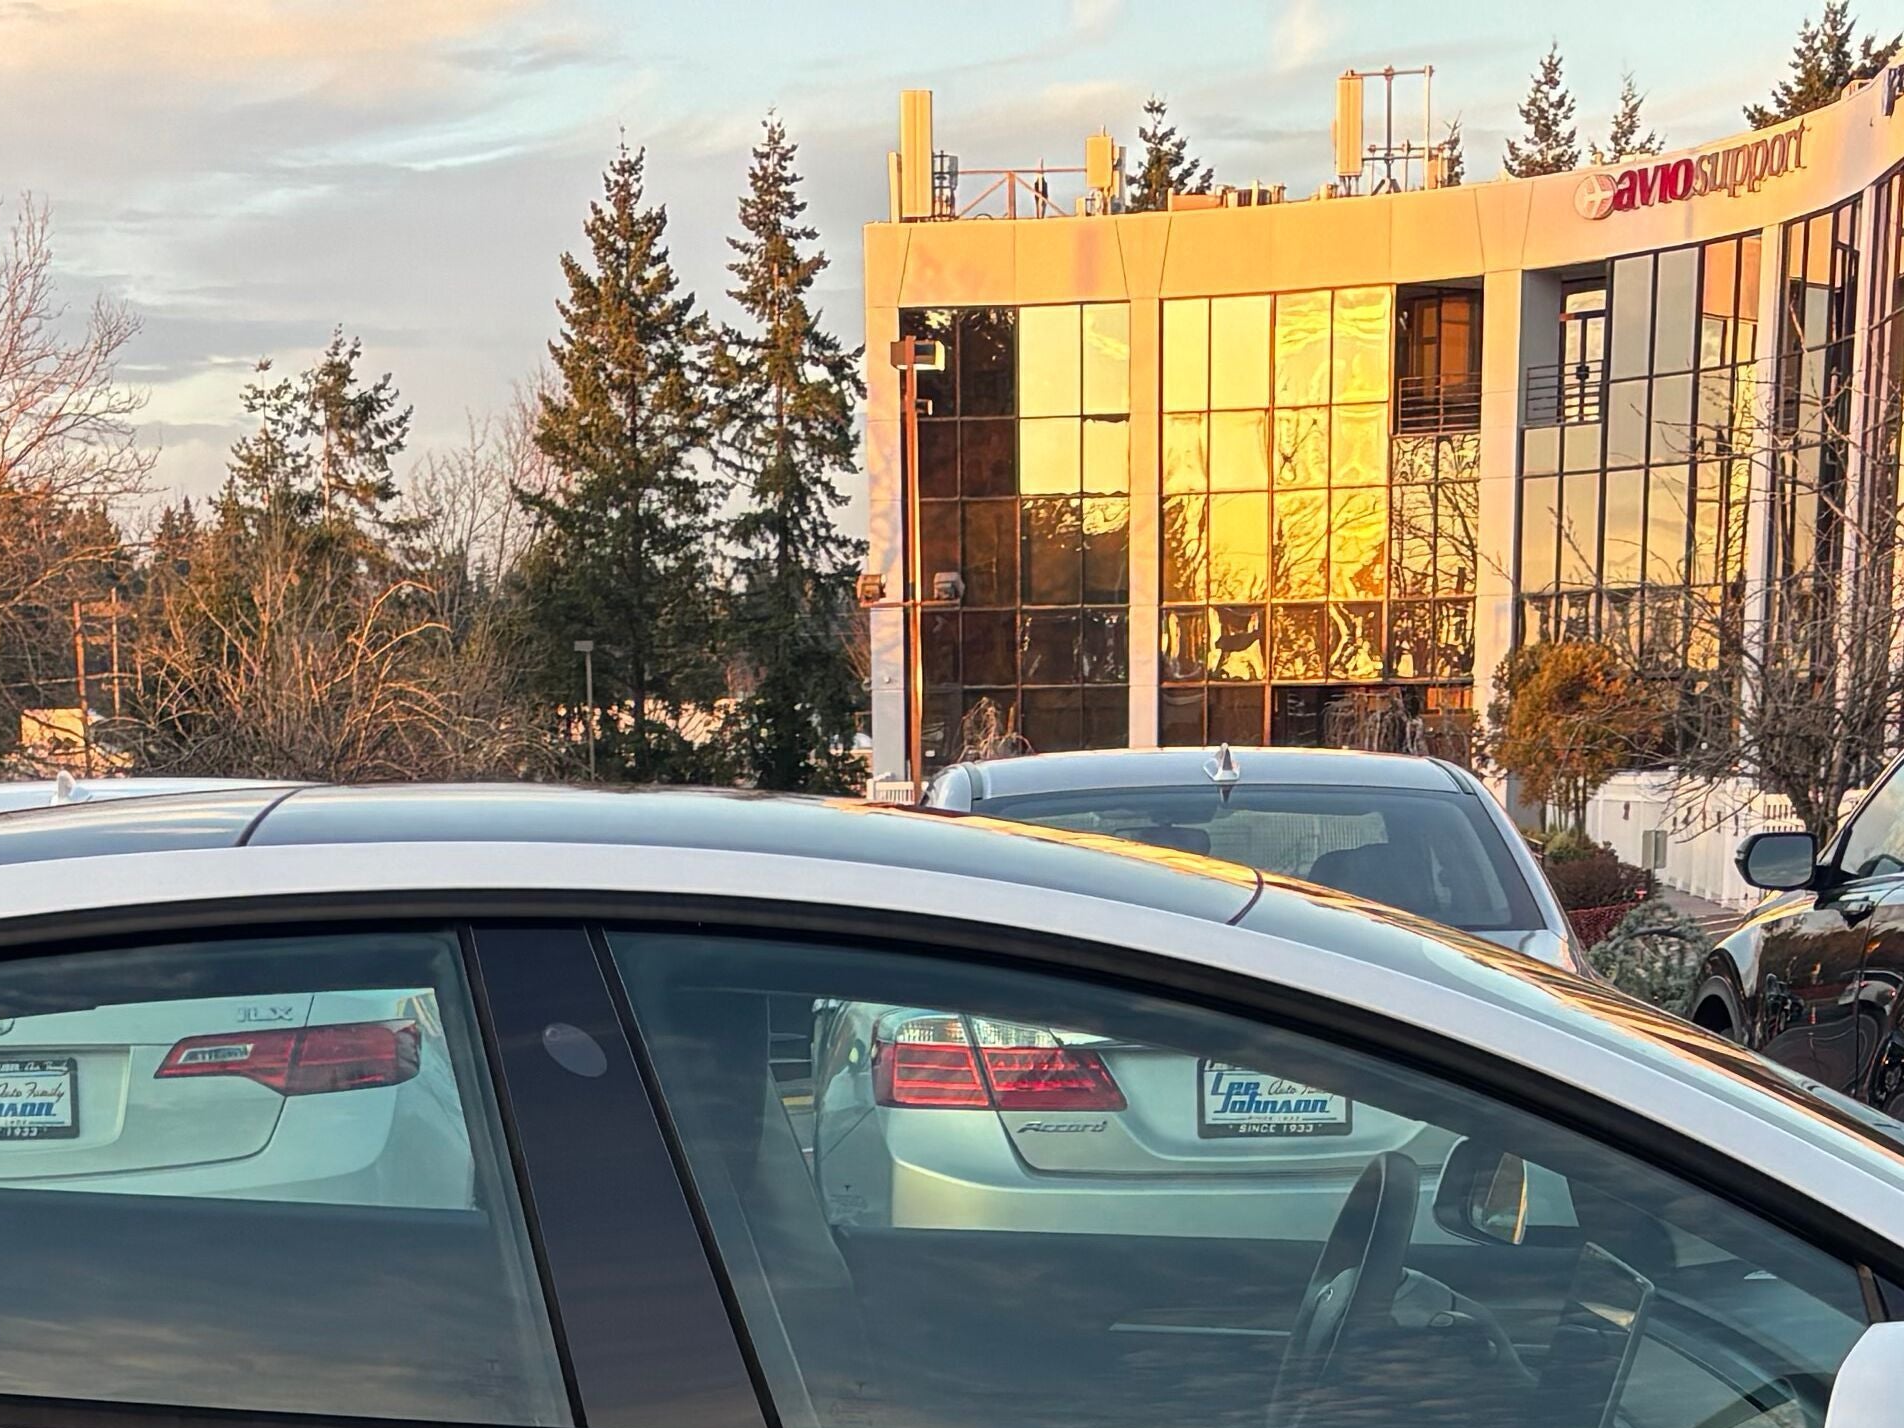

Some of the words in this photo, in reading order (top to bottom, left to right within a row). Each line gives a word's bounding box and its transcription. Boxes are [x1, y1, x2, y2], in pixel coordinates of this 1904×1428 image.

[25, 1081, 65, 1102] Family
[1211, 1072, 1262, 1096] Lee
[1213, 1090, 1331, 1114] Johnson
[1016, 1120, 1107, 1133] Accord
[1239, 1124, 1276, 1133] SINCE
[1283, 1124, 1314, 1132] 1933
